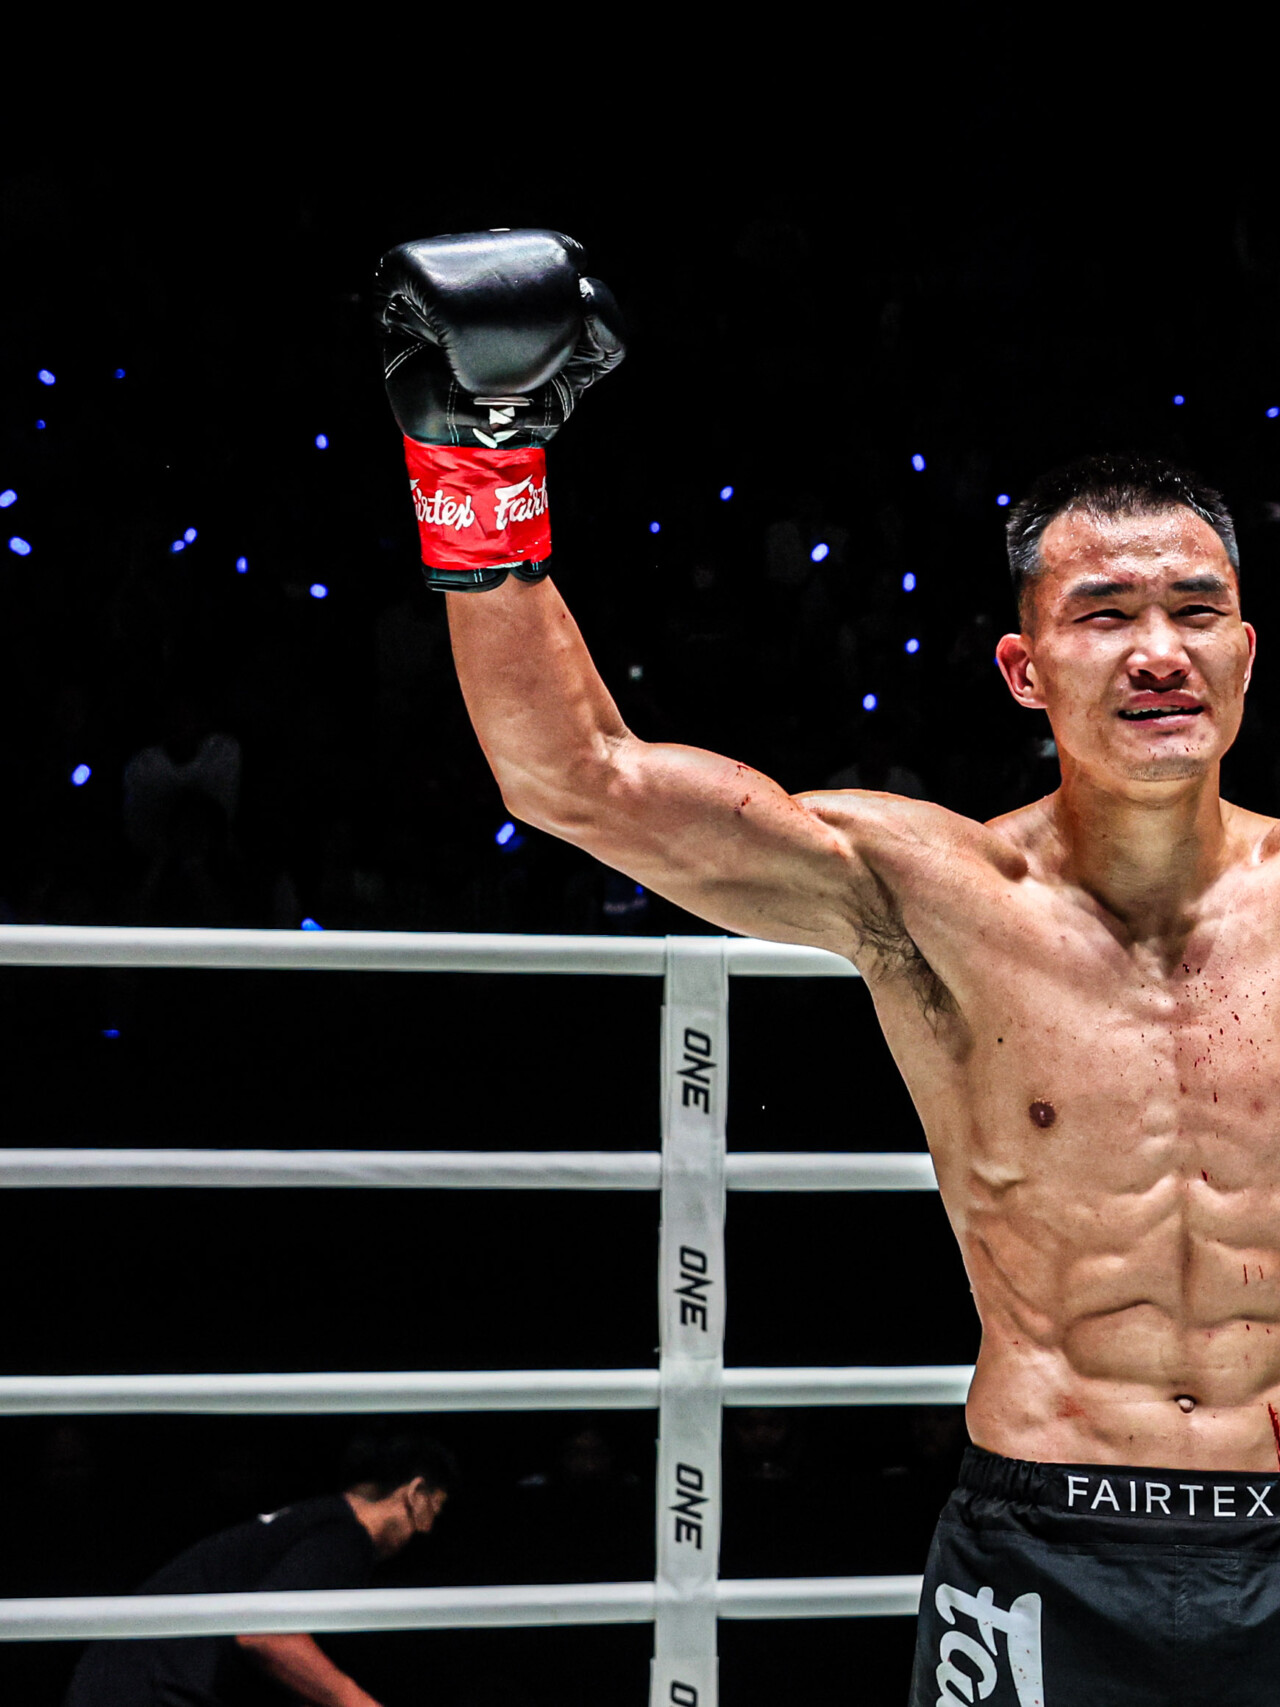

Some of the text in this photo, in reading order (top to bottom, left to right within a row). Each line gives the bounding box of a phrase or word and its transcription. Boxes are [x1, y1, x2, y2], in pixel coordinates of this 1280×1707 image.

[677, 1028, 716, 1115] ONE
[675, 1245, 713, 1333] ONE
[670, 1462, 708, 1551] ONE
[1067, 1475, 1274, 1517] FAIRTEX
